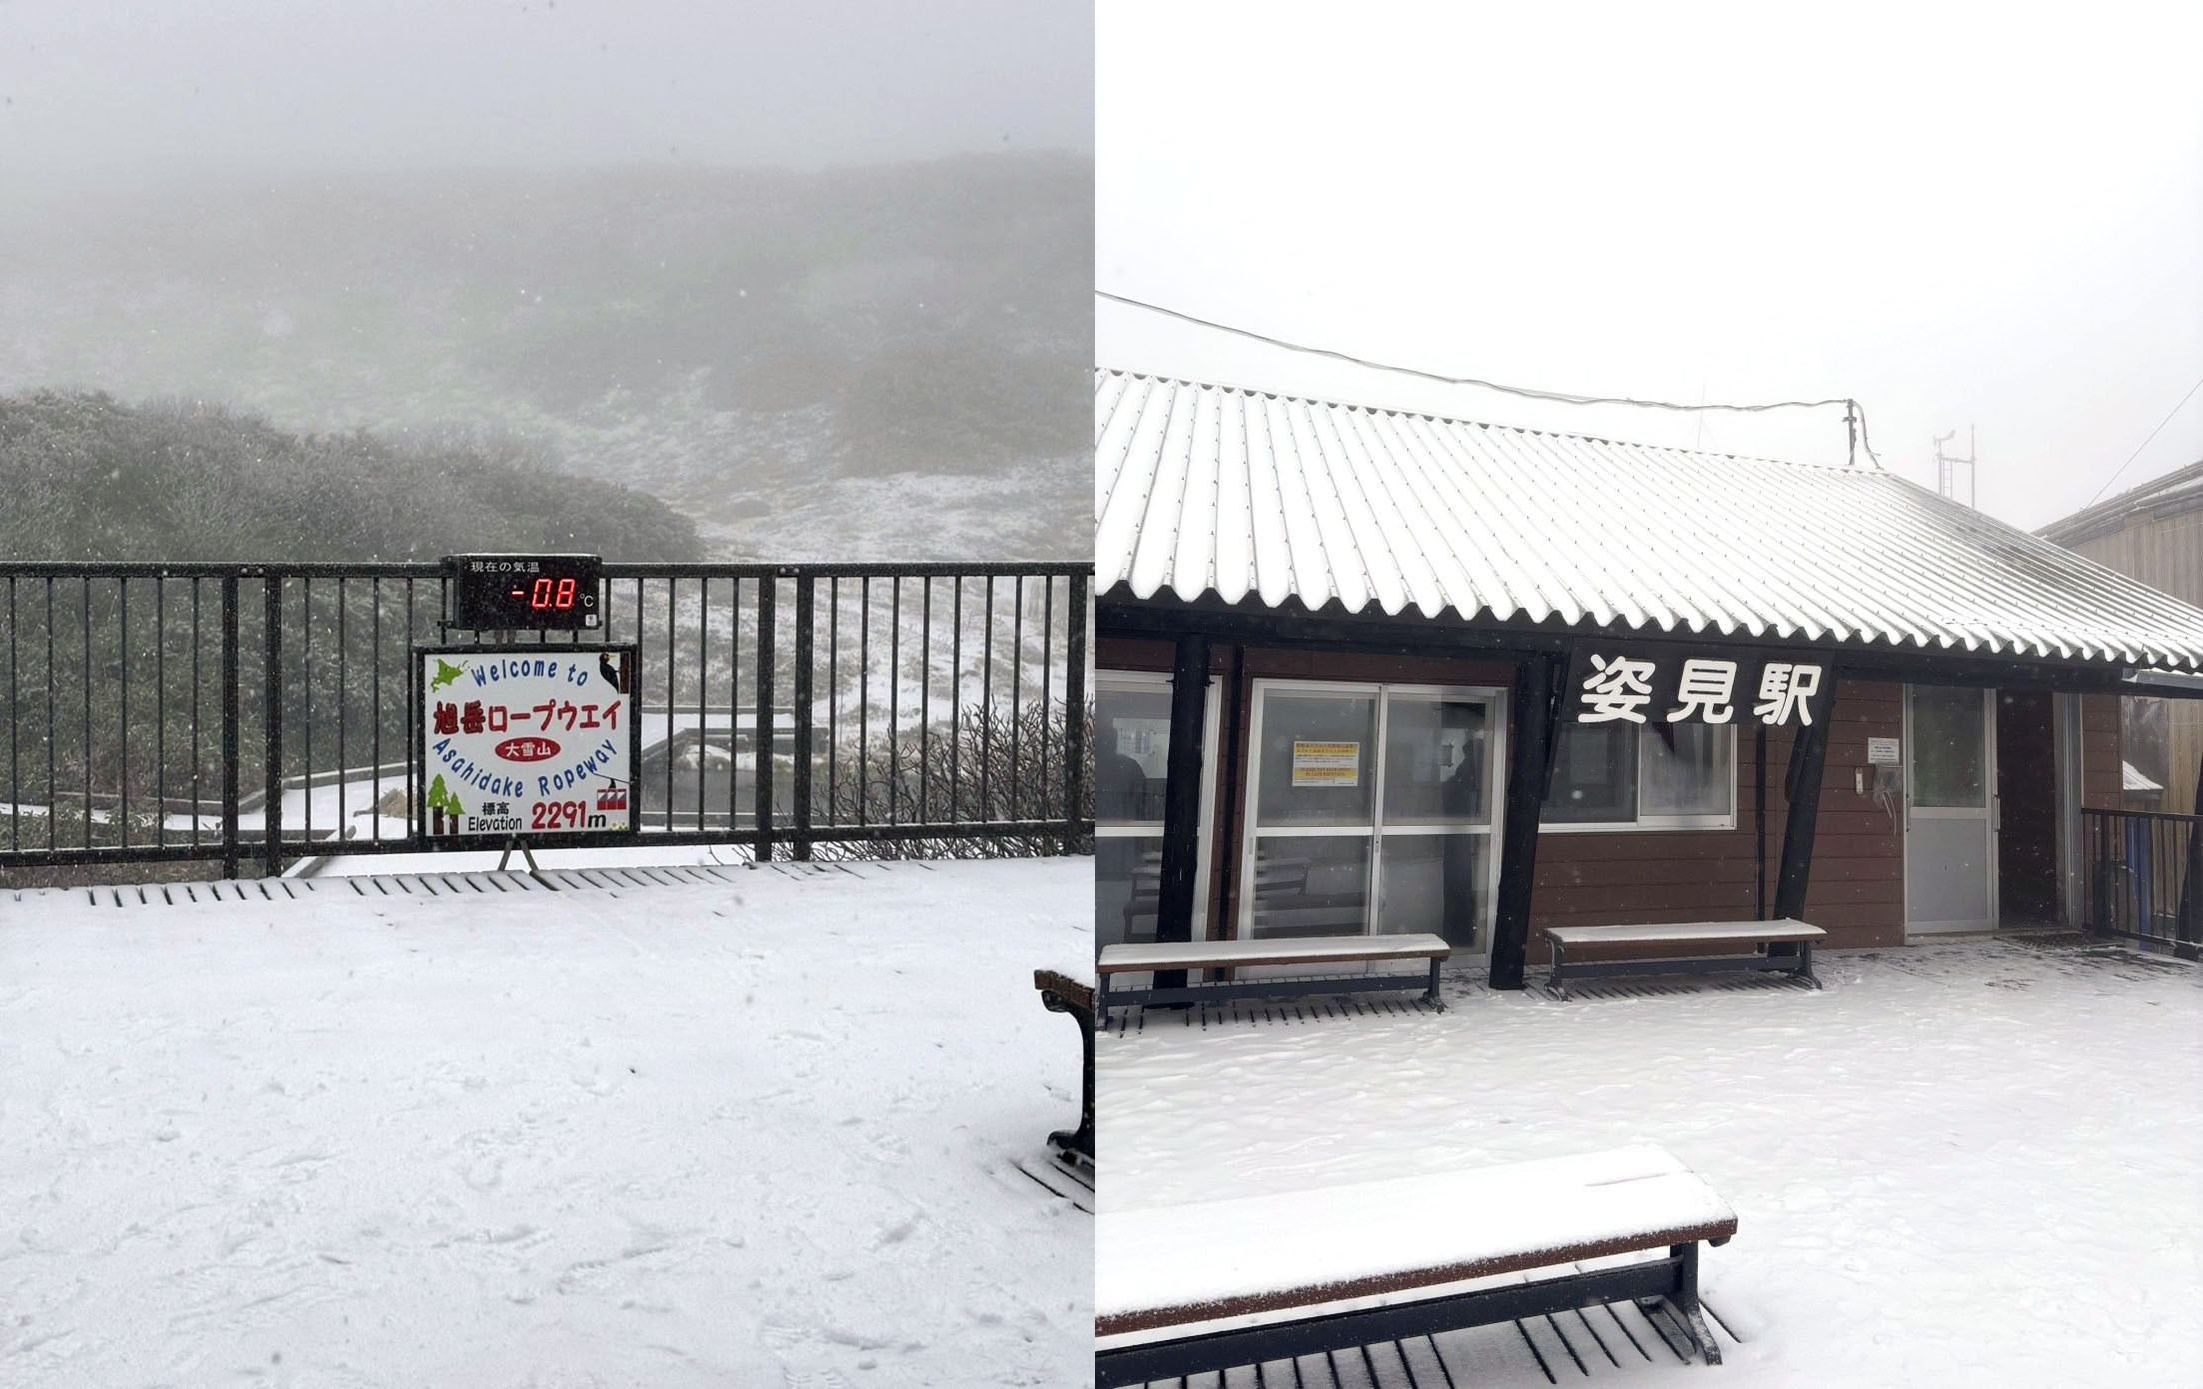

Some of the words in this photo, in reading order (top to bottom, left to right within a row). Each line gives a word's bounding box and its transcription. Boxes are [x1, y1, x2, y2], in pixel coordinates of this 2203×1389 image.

[470, 561, 540, 573] 現在の気温
[471, 658, 558, 688] Welcome
[567, 663, 589, 687] to
[1577, 653, 1822, 727] 姿見駅
[433, 699, 622, 735] 旭岳ロープウエイ
[504, 741, 552, 758] 大雪山
[432, 737, 525, 798] Asahidake
[538, 738, 618, 797] Ropeway
[481, 801, 510, 816] 標高
[468, 815, 523, 832] Elevation
